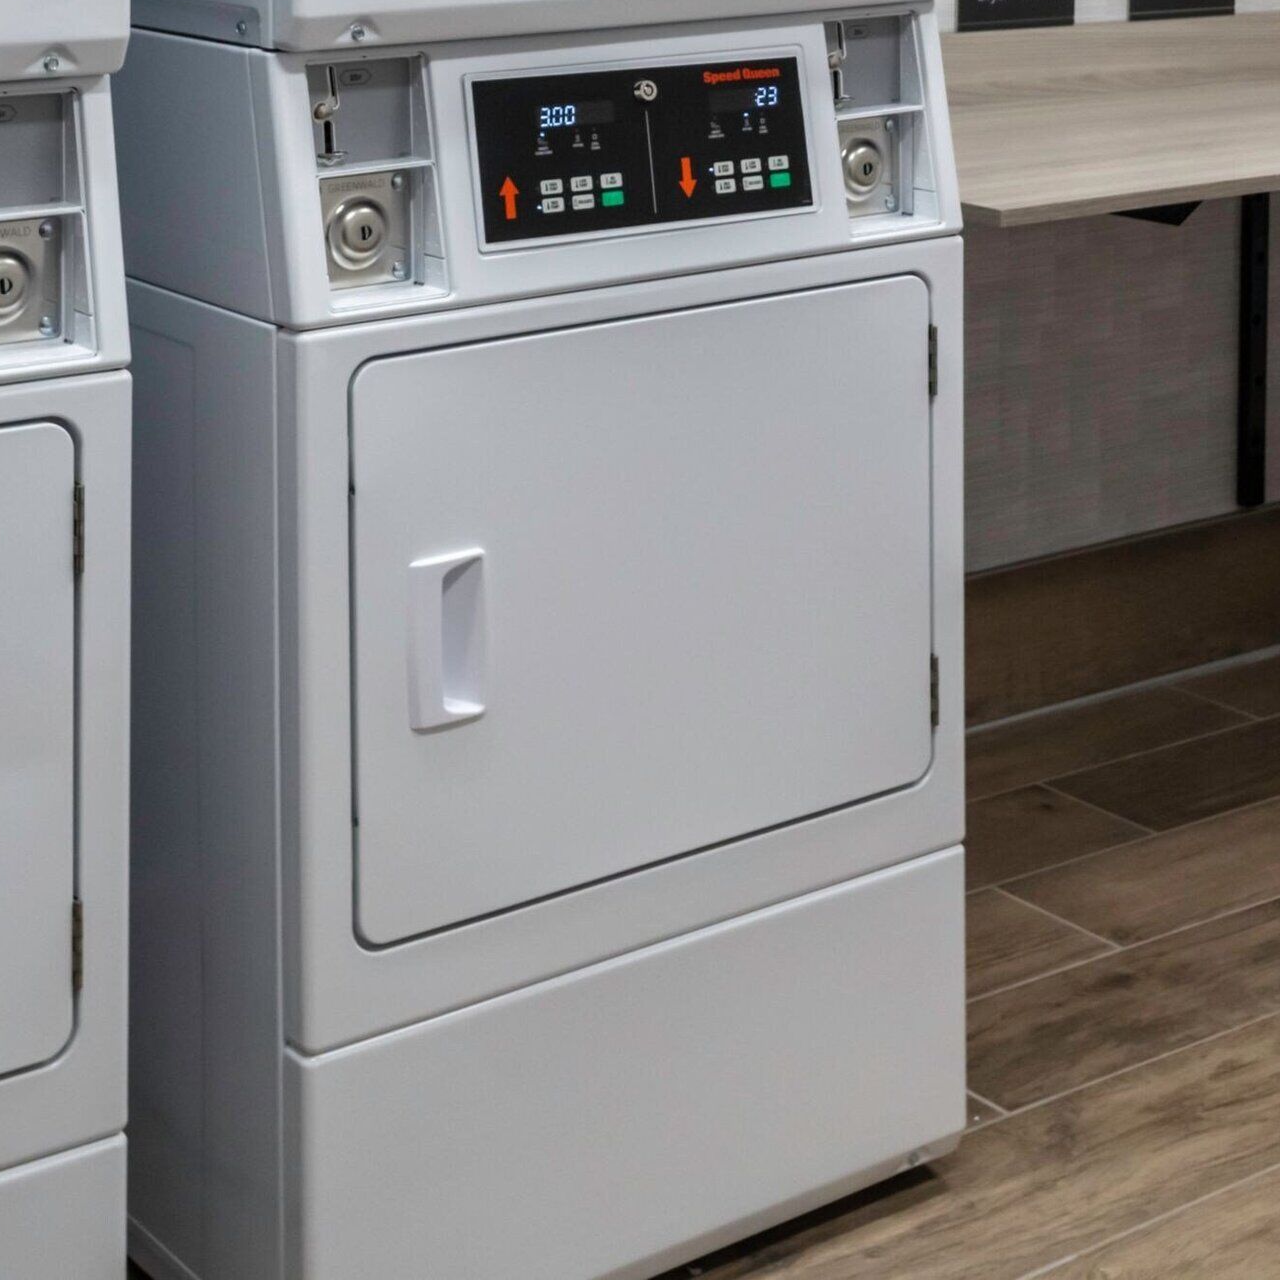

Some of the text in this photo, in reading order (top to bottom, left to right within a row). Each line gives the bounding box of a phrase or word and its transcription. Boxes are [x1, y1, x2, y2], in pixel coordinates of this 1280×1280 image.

[703, 67, 780, 84] Speed Queen
[540, 105, 576, 128] 3.00
